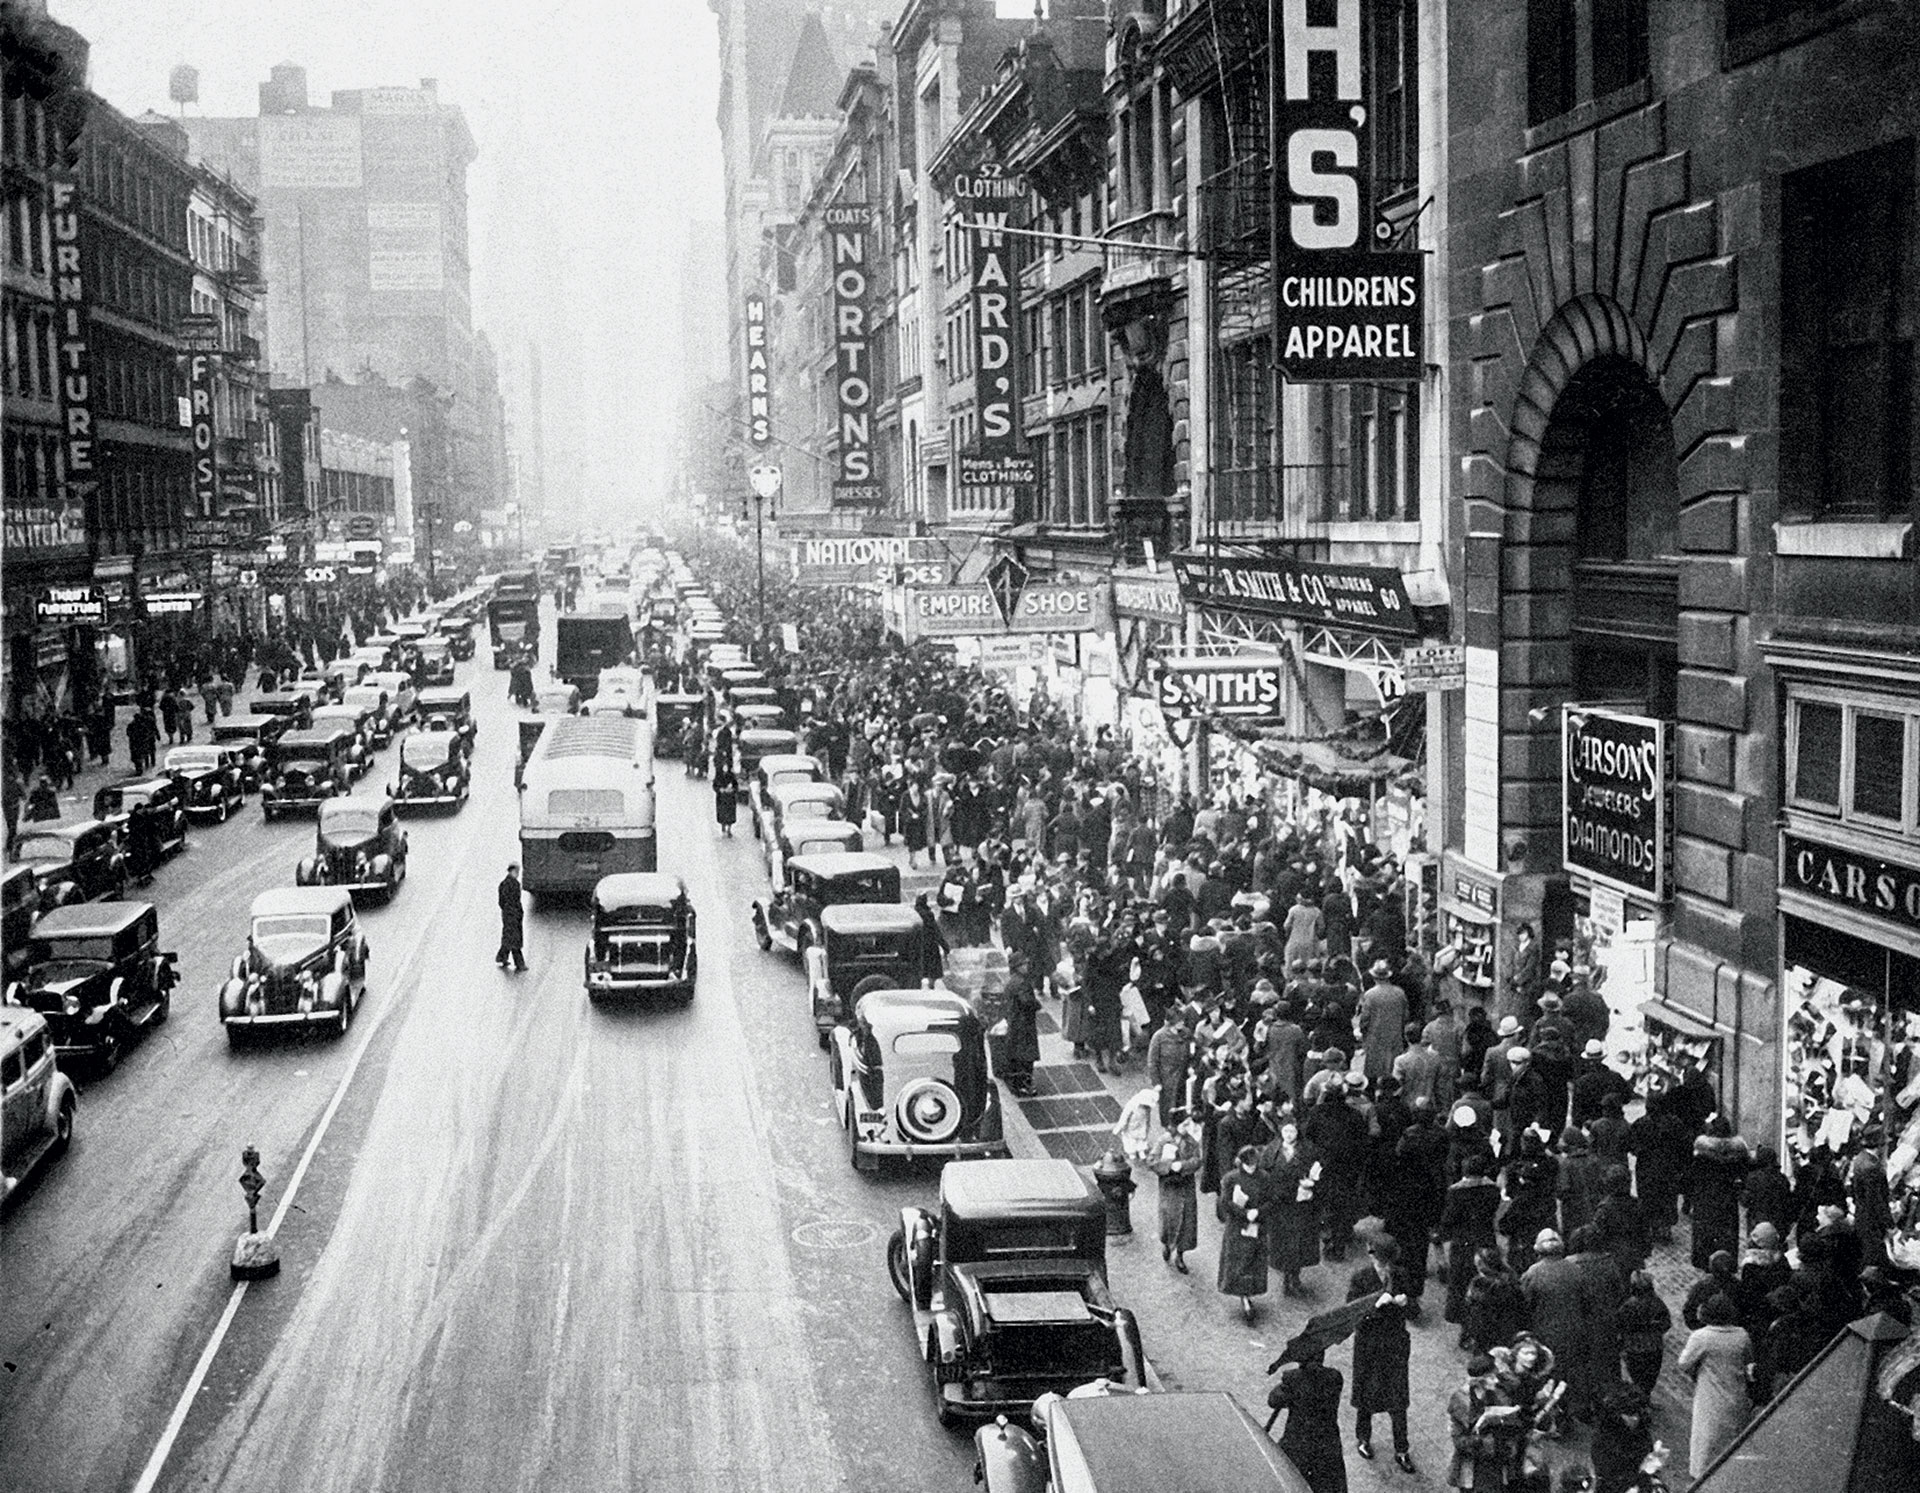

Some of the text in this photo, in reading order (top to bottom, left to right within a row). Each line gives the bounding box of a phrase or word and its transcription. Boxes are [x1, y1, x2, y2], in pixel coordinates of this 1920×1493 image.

[955, 173, 1026, 198] CLOTHING
[826, 208, 870, 224] COATS
[1282, 276, 1416, 307] CHILDRENS
[53, 182, 92, 470] FURNITURE
[974, 211, 1011, 437] WARD'S
[1285, 324, 1415, 358] APPAREL
[747, 302, 768, 441] HEARNS
[192, 356, 213, 517] FROST
[962, 470, 1034, 483] CLOTHING
[920, 595, 991, 615] EMPIRE
[1024, 591, 1089, 614] SHOE
[1286, 572, 1303, 603] &
[1163, 669, 1277, 703] SMITH'S
[1569, 729, 1655, 801] CARSON'S
